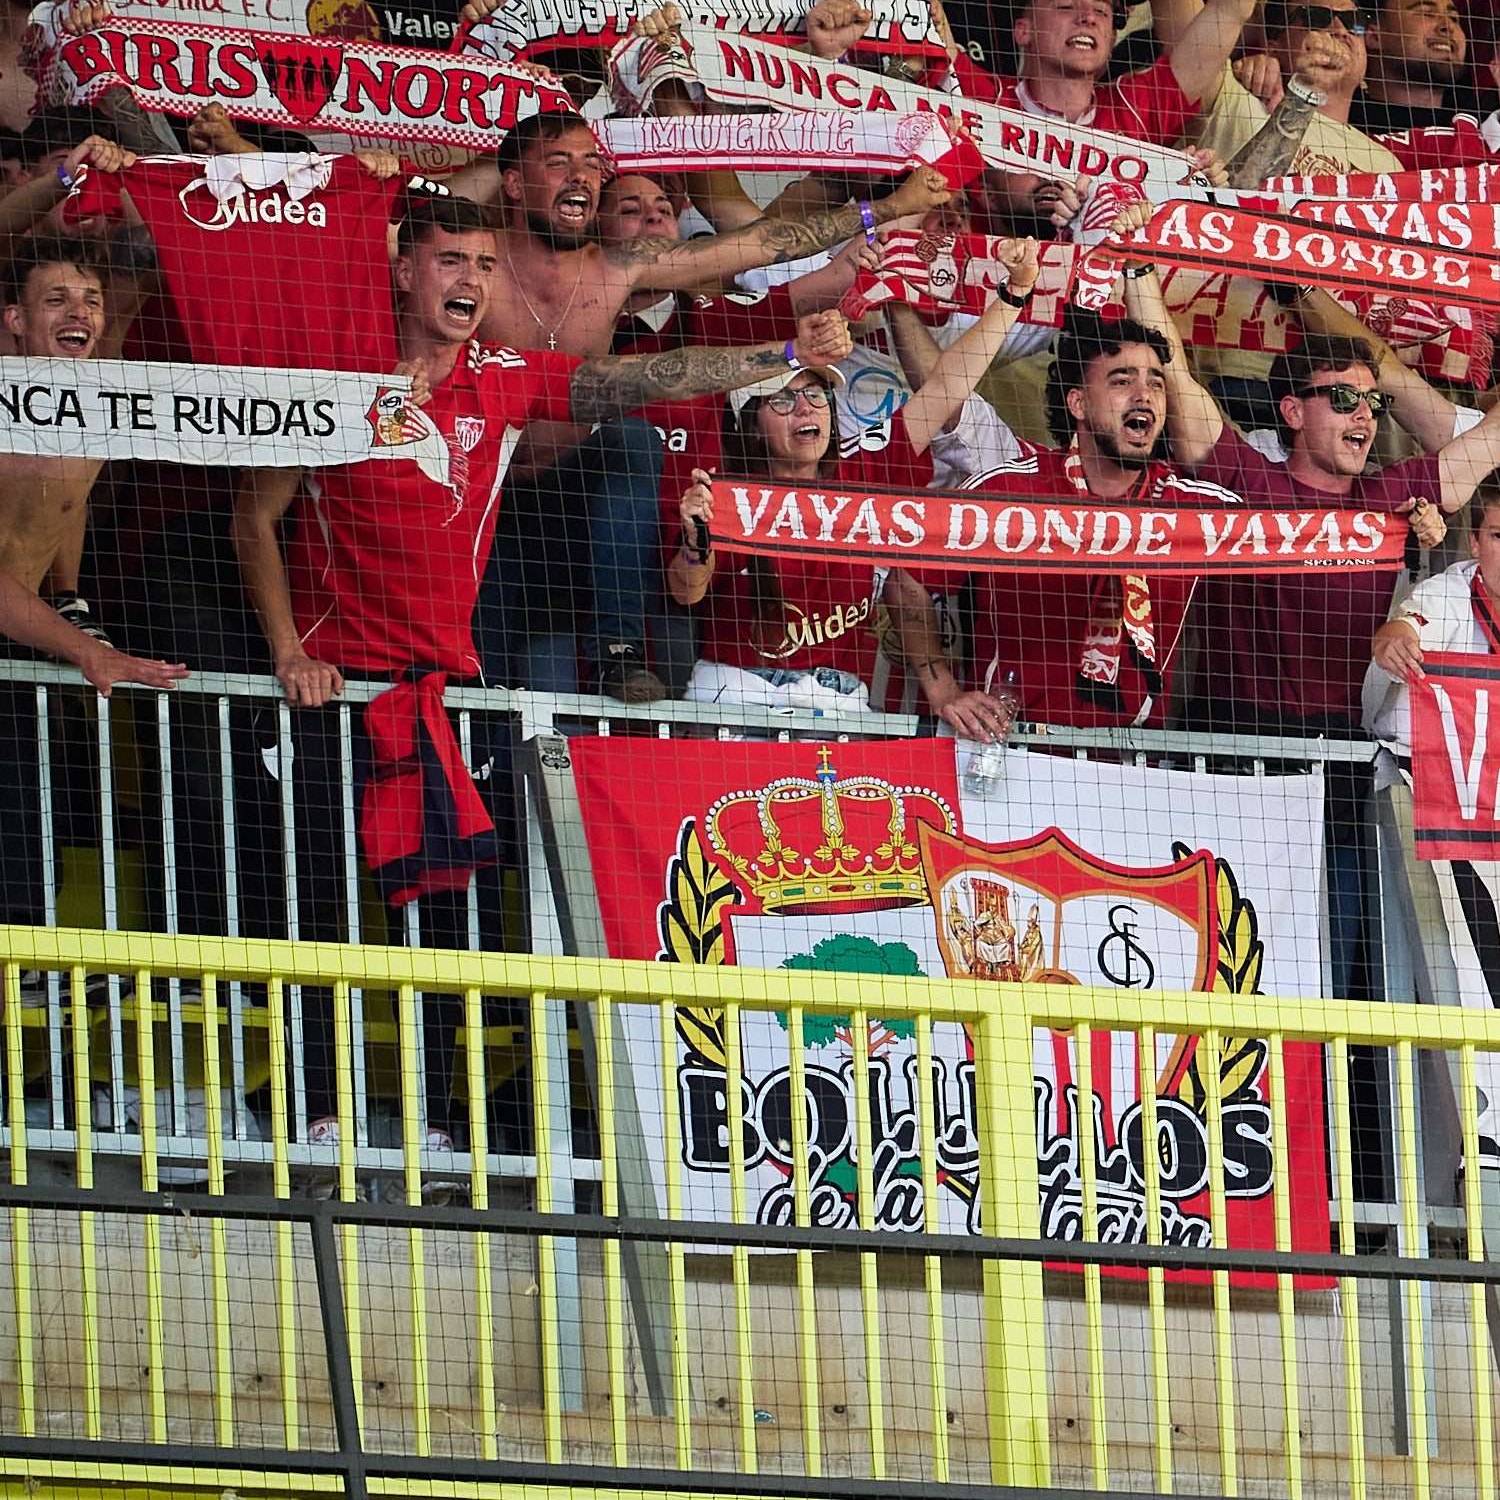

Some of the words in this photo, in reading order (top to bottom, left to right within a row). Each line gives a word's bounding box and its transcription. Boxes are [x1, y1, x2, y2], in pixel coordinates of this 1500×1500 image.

[62, 31, 258, 97] BIRIS
[341, 58, 577, 130] NORTE
[725, 41, 897, 111] NUNCA
[1001, 121, 1149, 184] RINDO
[216, 181, 326, 228] Midea
[1253, 222, 1470, 288] DONDE
[98, 391, 156, 430] TE
[174, 396, 335, 437] RINDAS
[731, 488, 924, 548] VAYAS
[944, 500, 1174, 557] DONDE
[1198, 509, 1387, 556] VAYAS
[792, 597, 872, 648] Midea
[679, 1055, 1277, 1200] BOLLLLOS
